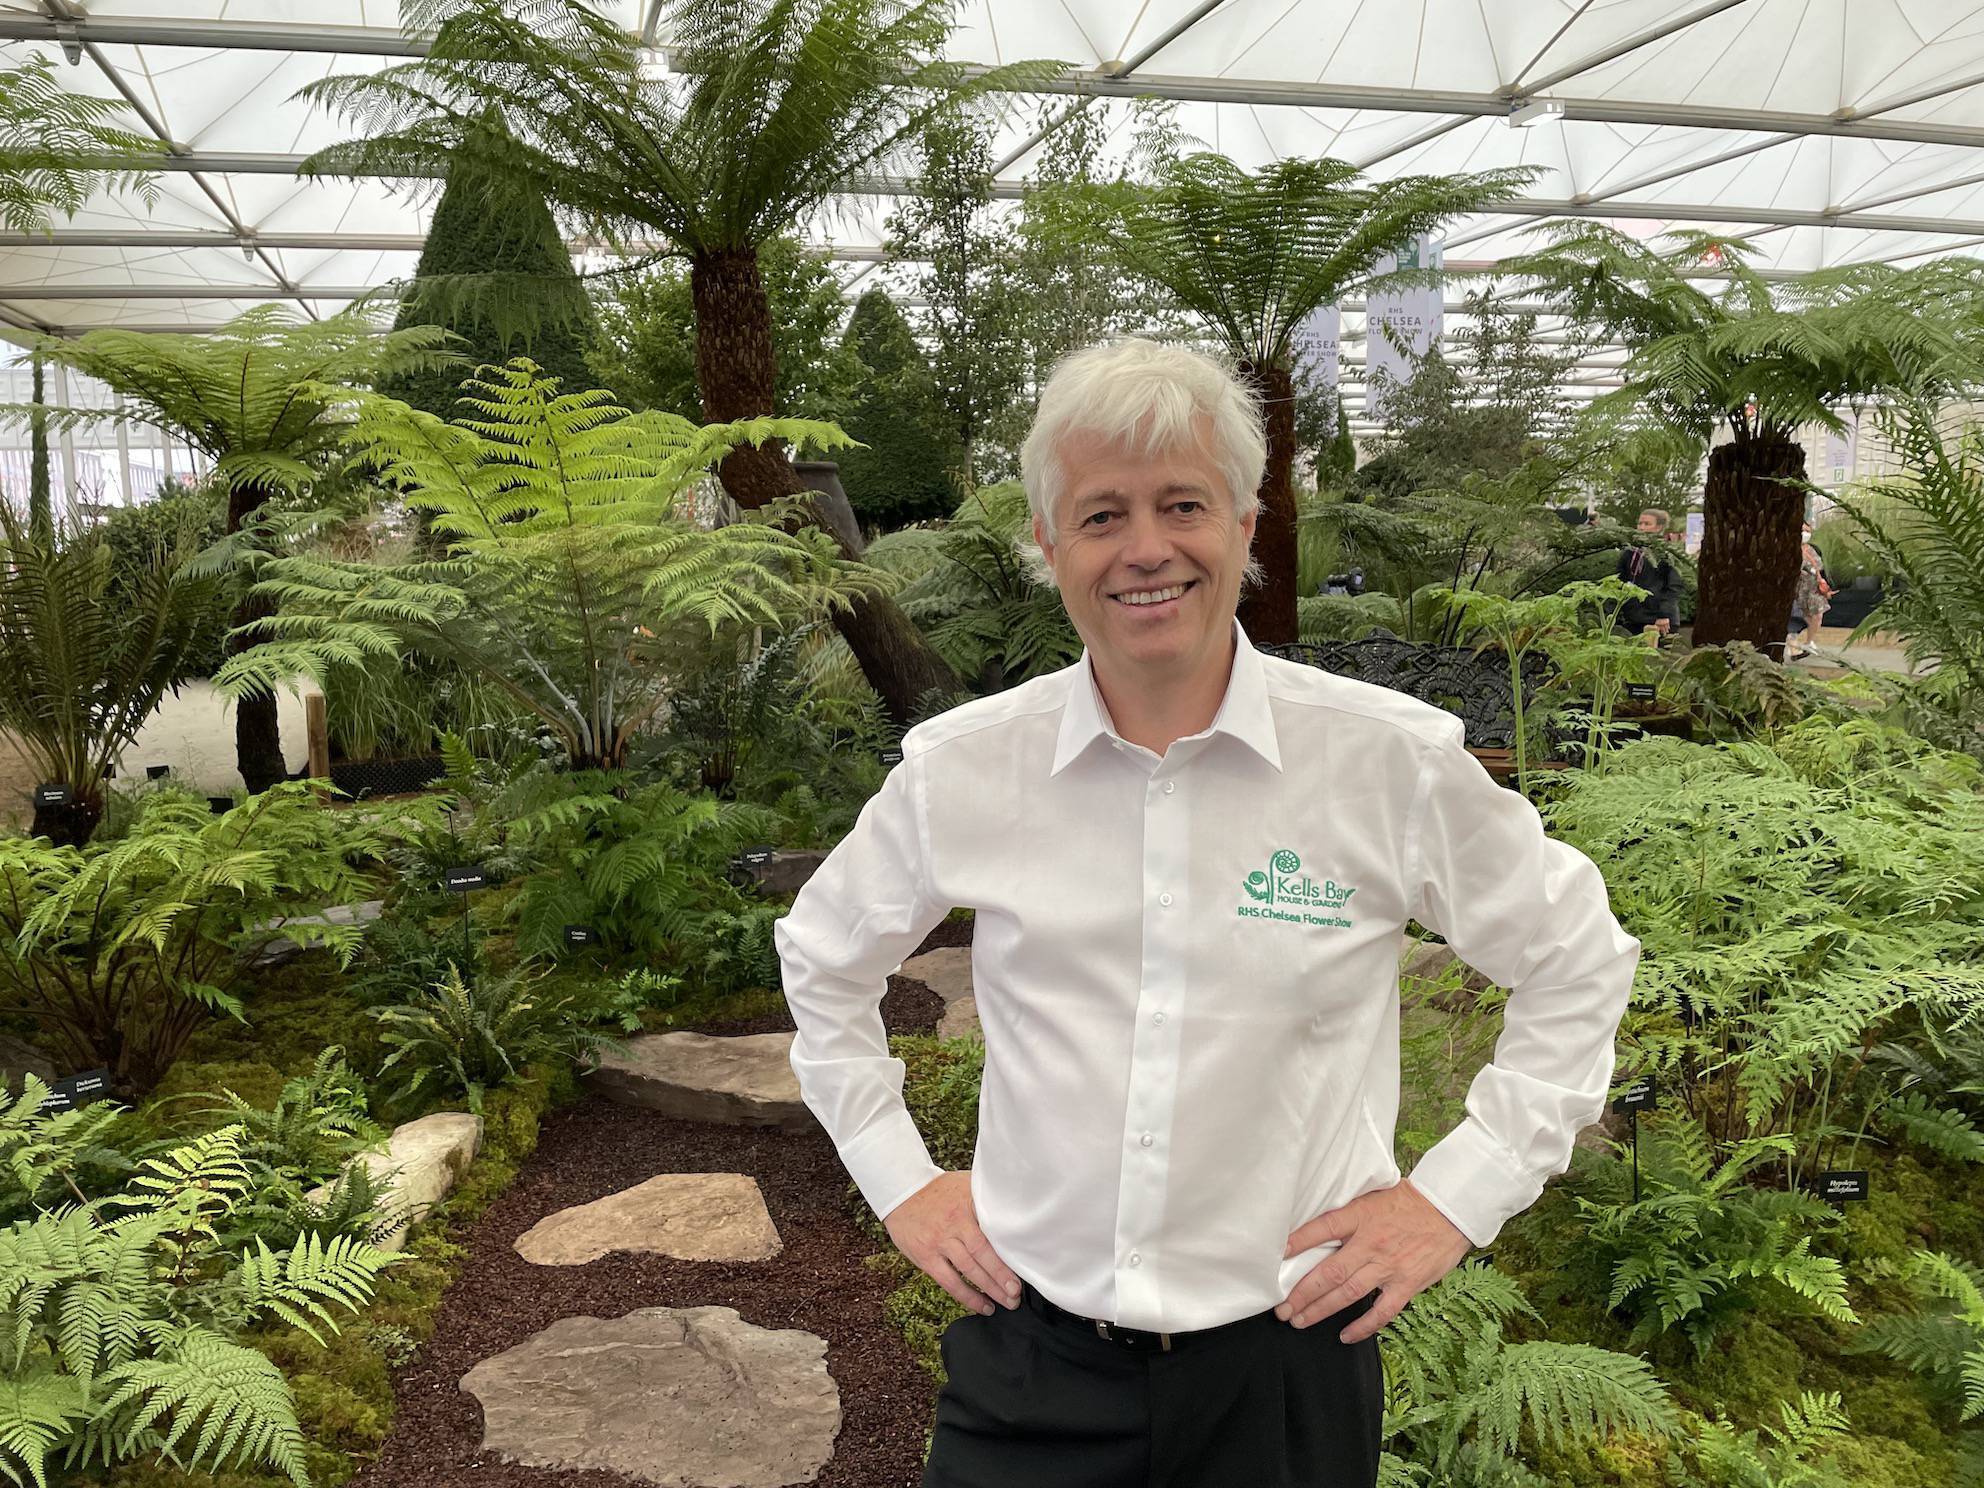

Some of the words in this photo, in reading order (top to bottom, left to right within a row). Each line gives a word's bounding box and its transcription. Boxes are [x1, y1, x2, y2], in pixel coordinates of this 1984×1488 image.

[1369, 316, 1422, 326] CHELSEA
[1277, 876, 1320, 898] Kells
[1325, 880, 1356, 906] Bay
[1277, 895, 1303, 904] HOUSE
[1238, 906, 1260, 918] RHS
[1261, 908, 1301, 923] Chelsea
